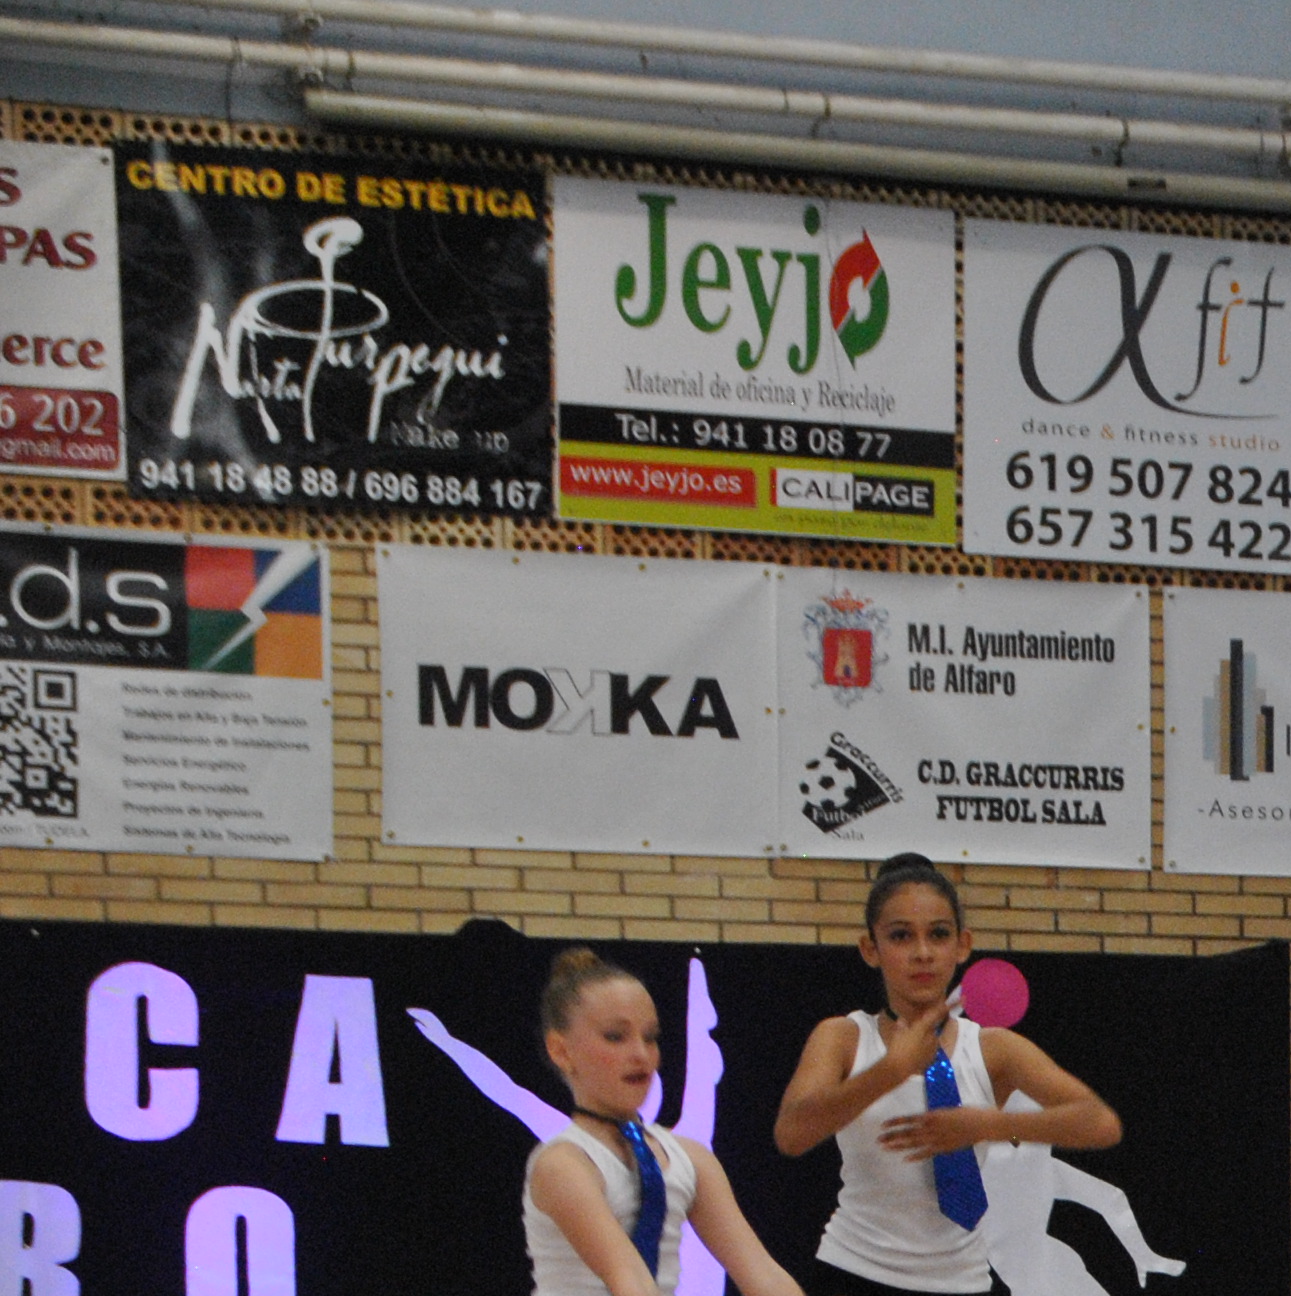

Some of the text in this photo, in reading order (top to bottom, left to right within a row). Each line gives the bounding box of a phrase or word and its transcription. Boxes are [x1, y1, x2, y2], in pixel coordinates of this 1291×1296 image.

[127, 159, 536, 220] CENTRO DE ESTÉTICA
[624, 365, 896, 417] Material de oficina y Reciclaje
[32, 393, 104, 437] 202
[615, 412, 891, 458] Tel.: 941 18 08 77
[1022, 417, 1281, 453] dance & fitness studio
[139, 459, 196, 491] 941
[208, 460, 246, 493] 18
[254, 463, 291, 496] 48
[301, 466, 339, 498] 88
[365, 470, 418, 501] 696
[427, 475, 480, 508] 884
[490, 479, 542, 511] 167
[570, 461, 742, 494] www.jeyjo.es
[1006, 451, 1094, 494] 619
[1108, 456, 1194, 501] 507
[1006, 505, 1093, 549] 657
[1109, 511, 1194, 554] 315
[907, 622, 1116, 664] M.I. Ayuntamiento
[909, 662, 1016, 697] de Alfaro
[917, 759, 1125, 792] C.D. GRACCURRIS
[935, 793, 1107, 826] FUTBOL SALA
